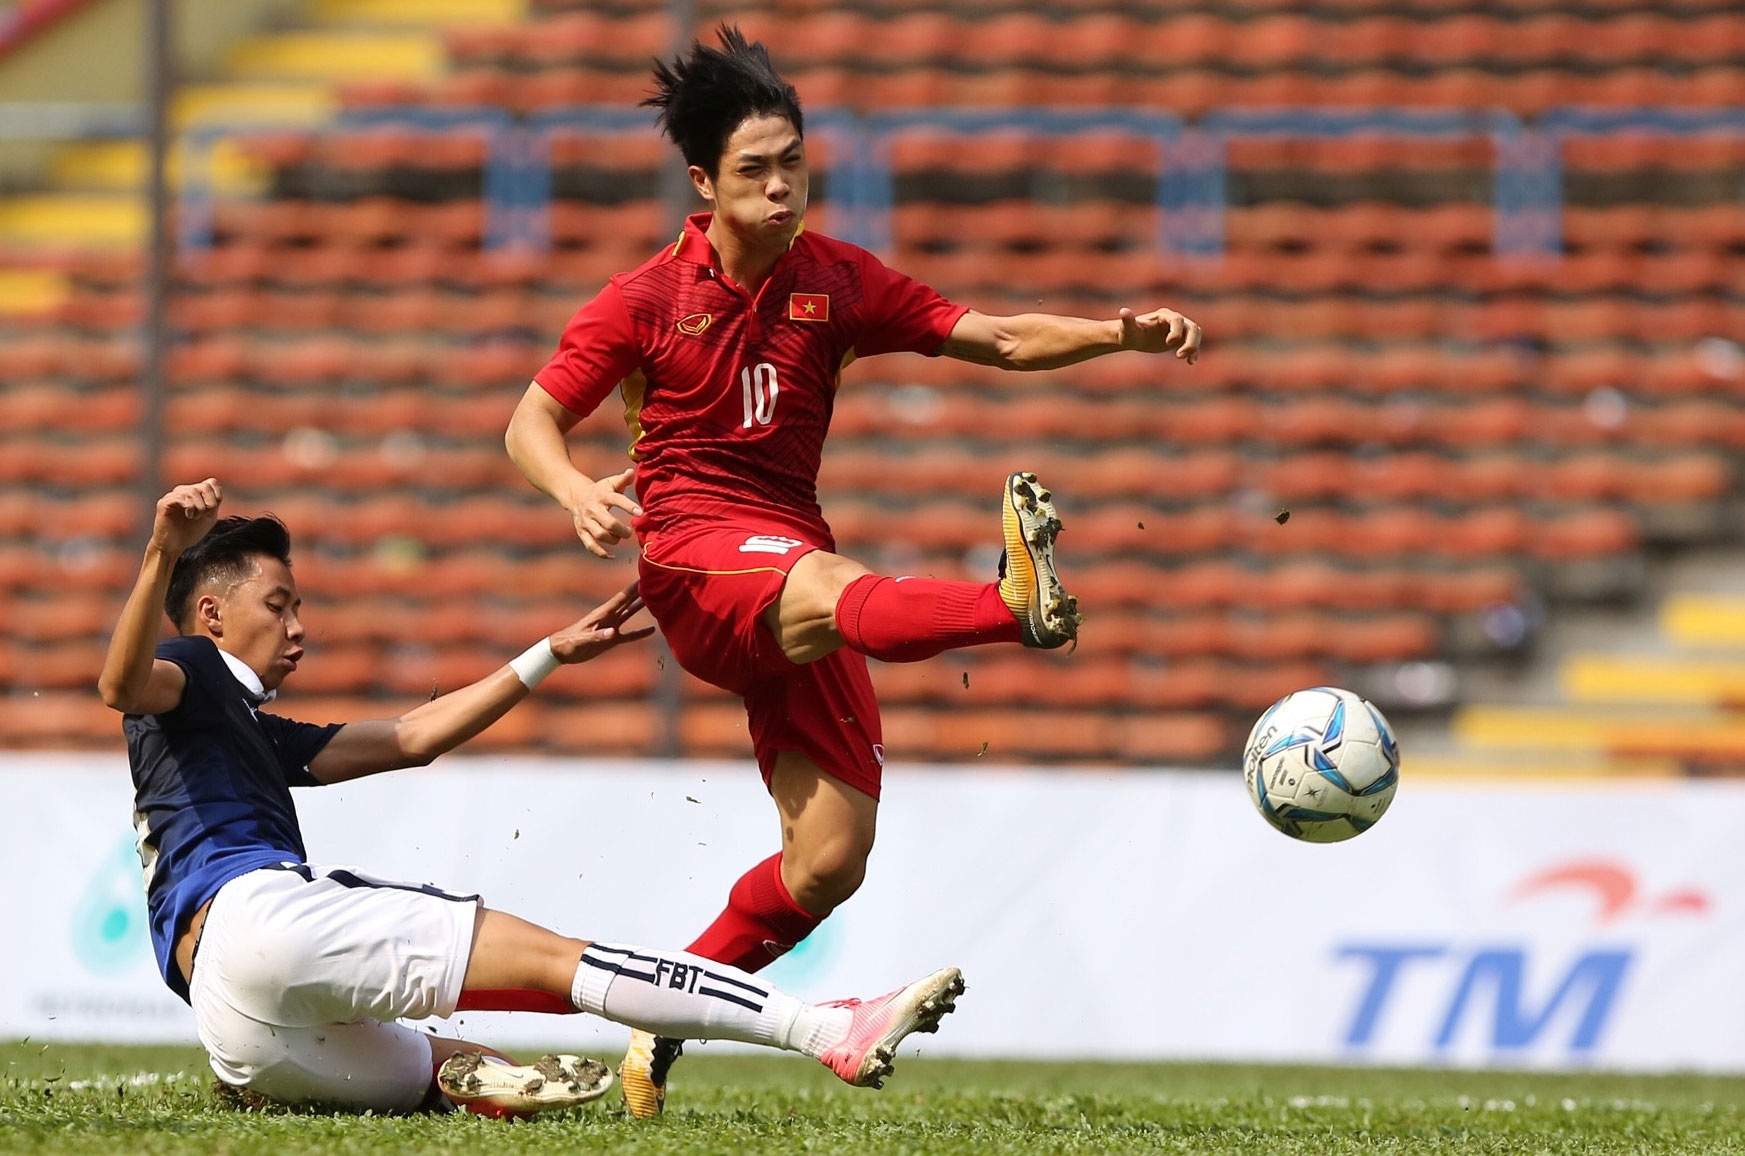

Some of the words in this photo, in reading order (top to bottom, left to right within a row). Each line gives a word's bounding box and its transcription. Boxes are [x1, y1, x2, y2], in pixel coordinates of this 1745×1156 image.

[742, 363, 779, 428] 10
[1247, 724, 1278, 793] molten
[656, 958, 704, 994] FBT
[1335, 943, 1634, 1049] TM
